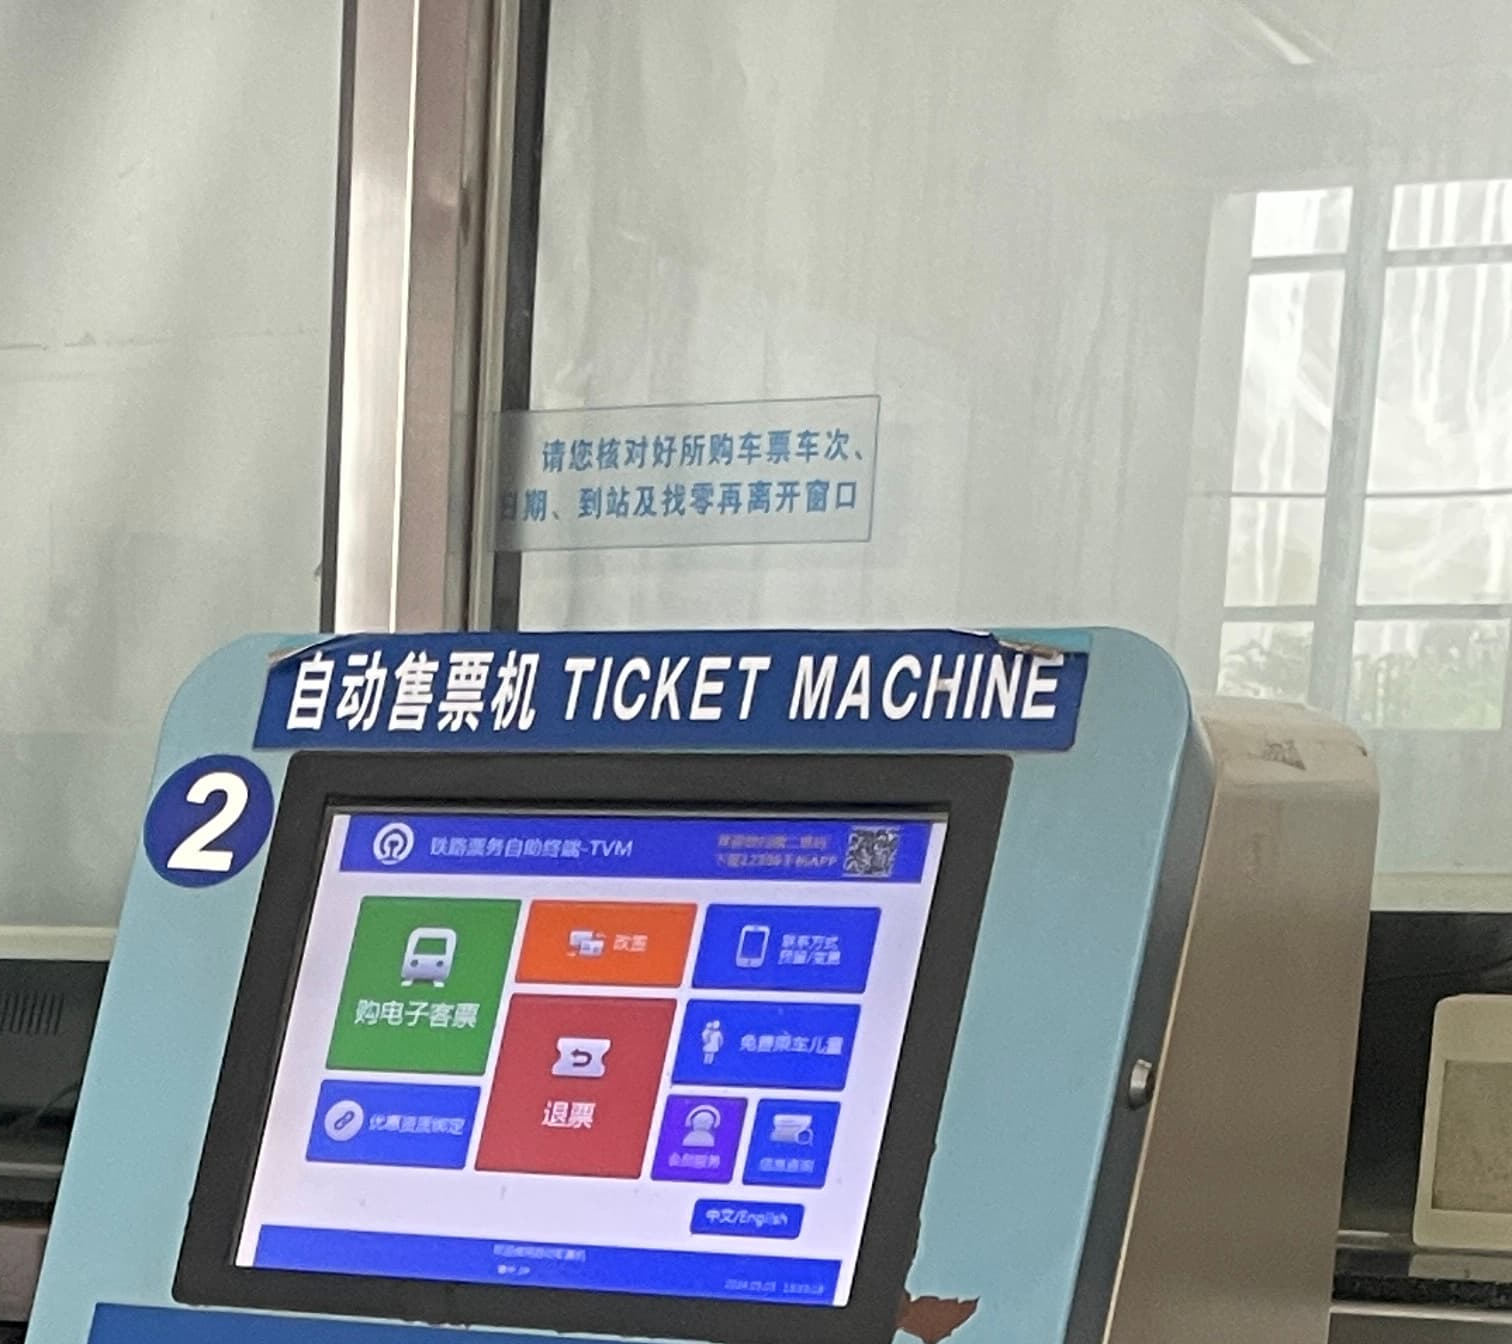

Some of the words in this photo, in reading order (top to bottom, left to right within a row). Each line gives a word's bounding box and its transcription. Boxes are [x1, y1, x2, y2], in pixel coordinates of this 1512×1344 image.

[542, 428, 863, 473] 请您核对好所购车票车次、
[287, 650, 539, 733] 自动售票机
[561, 655, 769, 722] TICKET
[788, 654, 1065, 721] MACHINE
[167, 770, 250, 872] 2
[355, 1000, 480, 1028] 购电子客票
[541, 1101, 596, 1129] 退票
